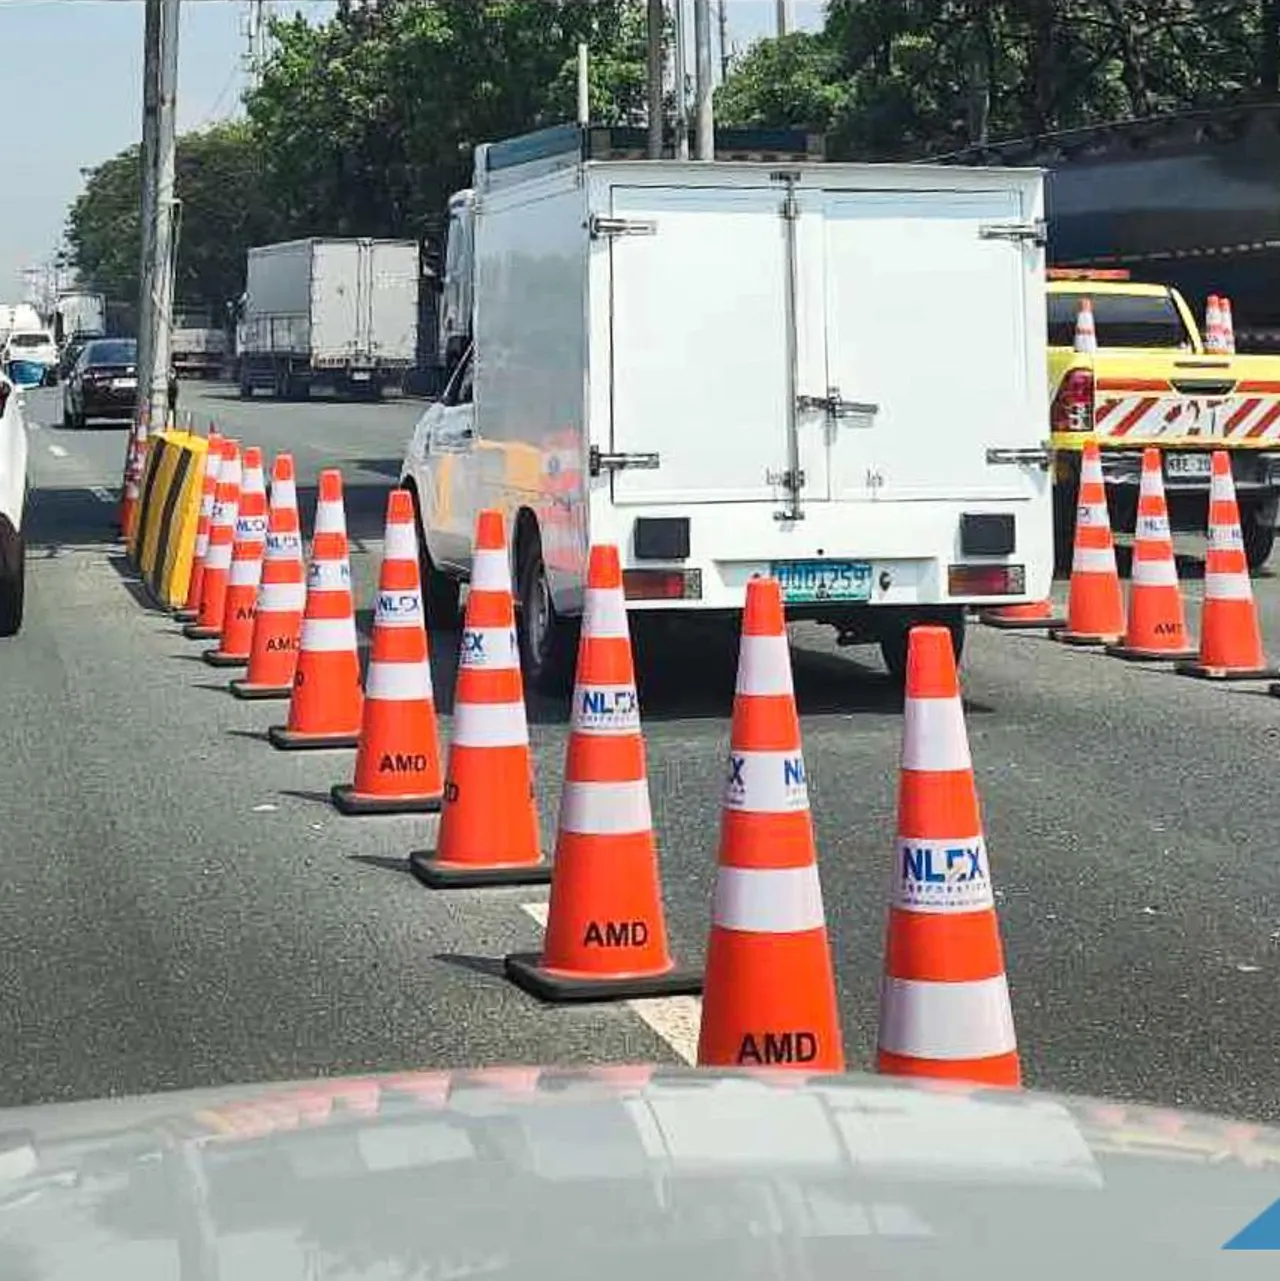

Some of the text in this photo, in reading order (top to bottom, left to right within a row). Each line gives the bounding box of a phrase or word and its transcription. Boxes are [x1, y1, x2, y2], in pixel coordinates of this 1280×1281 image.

[379, 753, 427, 773] AMD
[903, 846, 984, 883] NLEX
[583, 921, 648, 948] AMD
[737, 1032, 818, 1065] AMD
